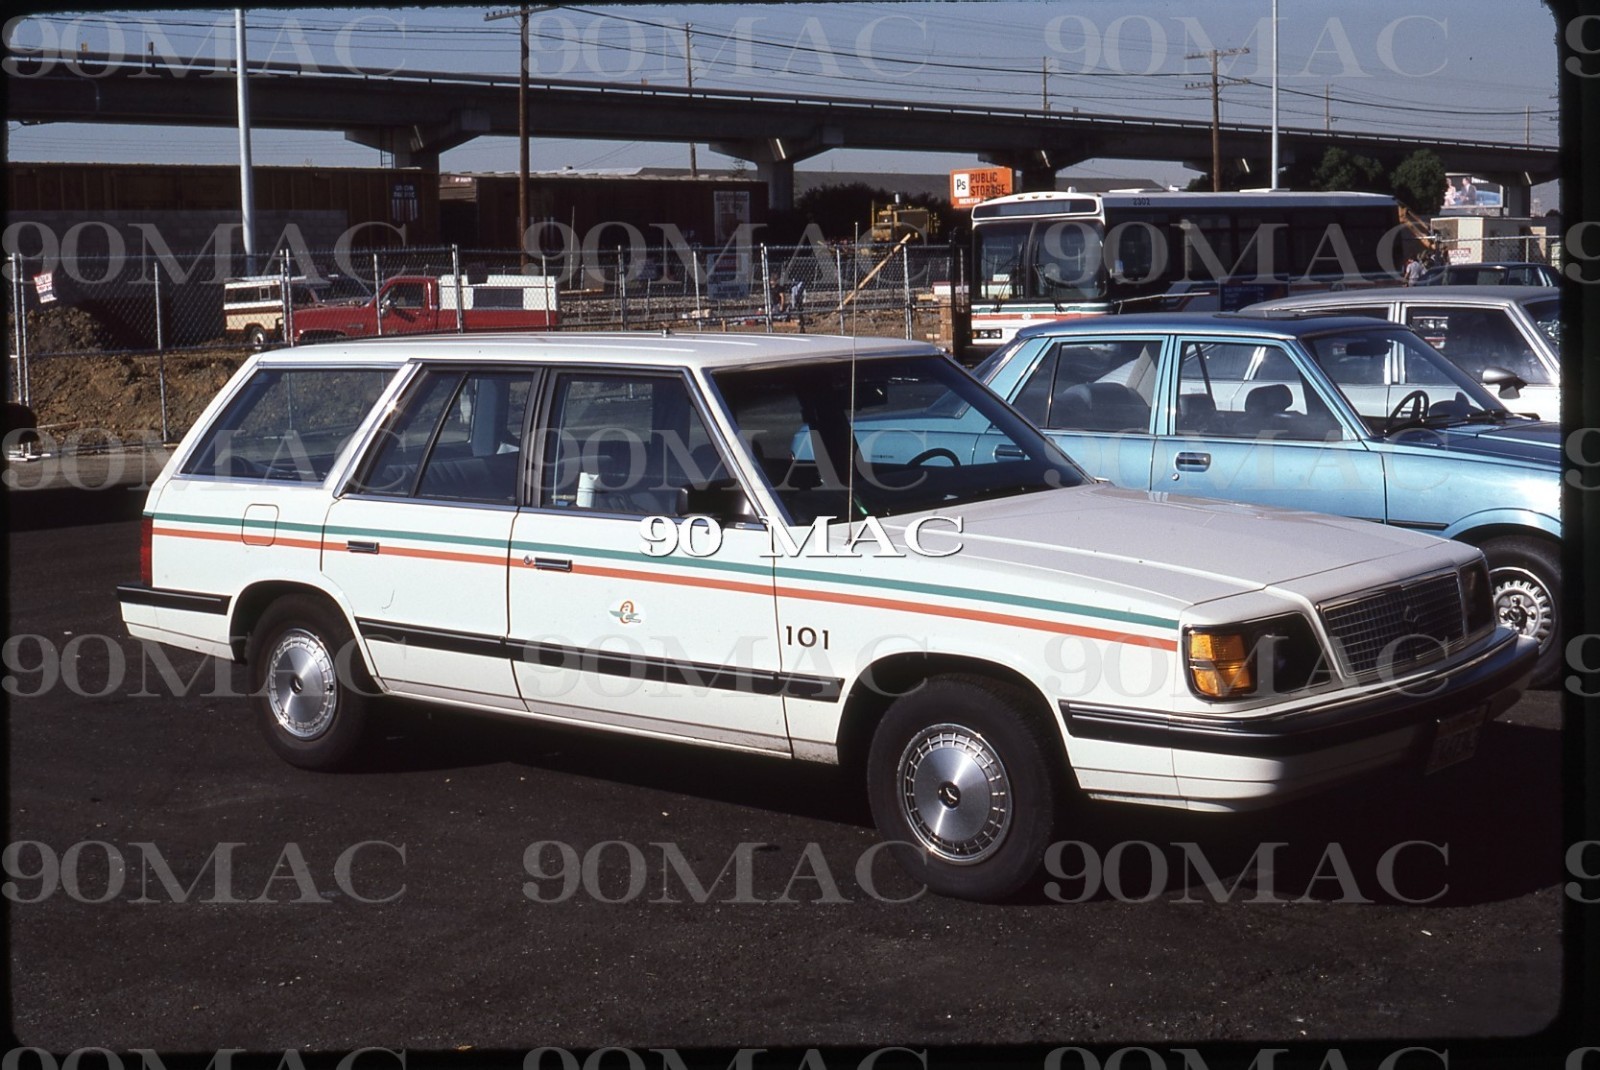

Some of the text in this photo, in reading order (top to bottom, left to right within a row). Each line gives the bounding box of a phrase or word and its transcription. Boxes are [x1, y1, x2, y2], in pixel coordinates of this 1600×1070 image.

[956, 178, 967, 191] Ps
[970, 172, 998, 184] PUBLIC
[785, 625, 830, 651] 101
